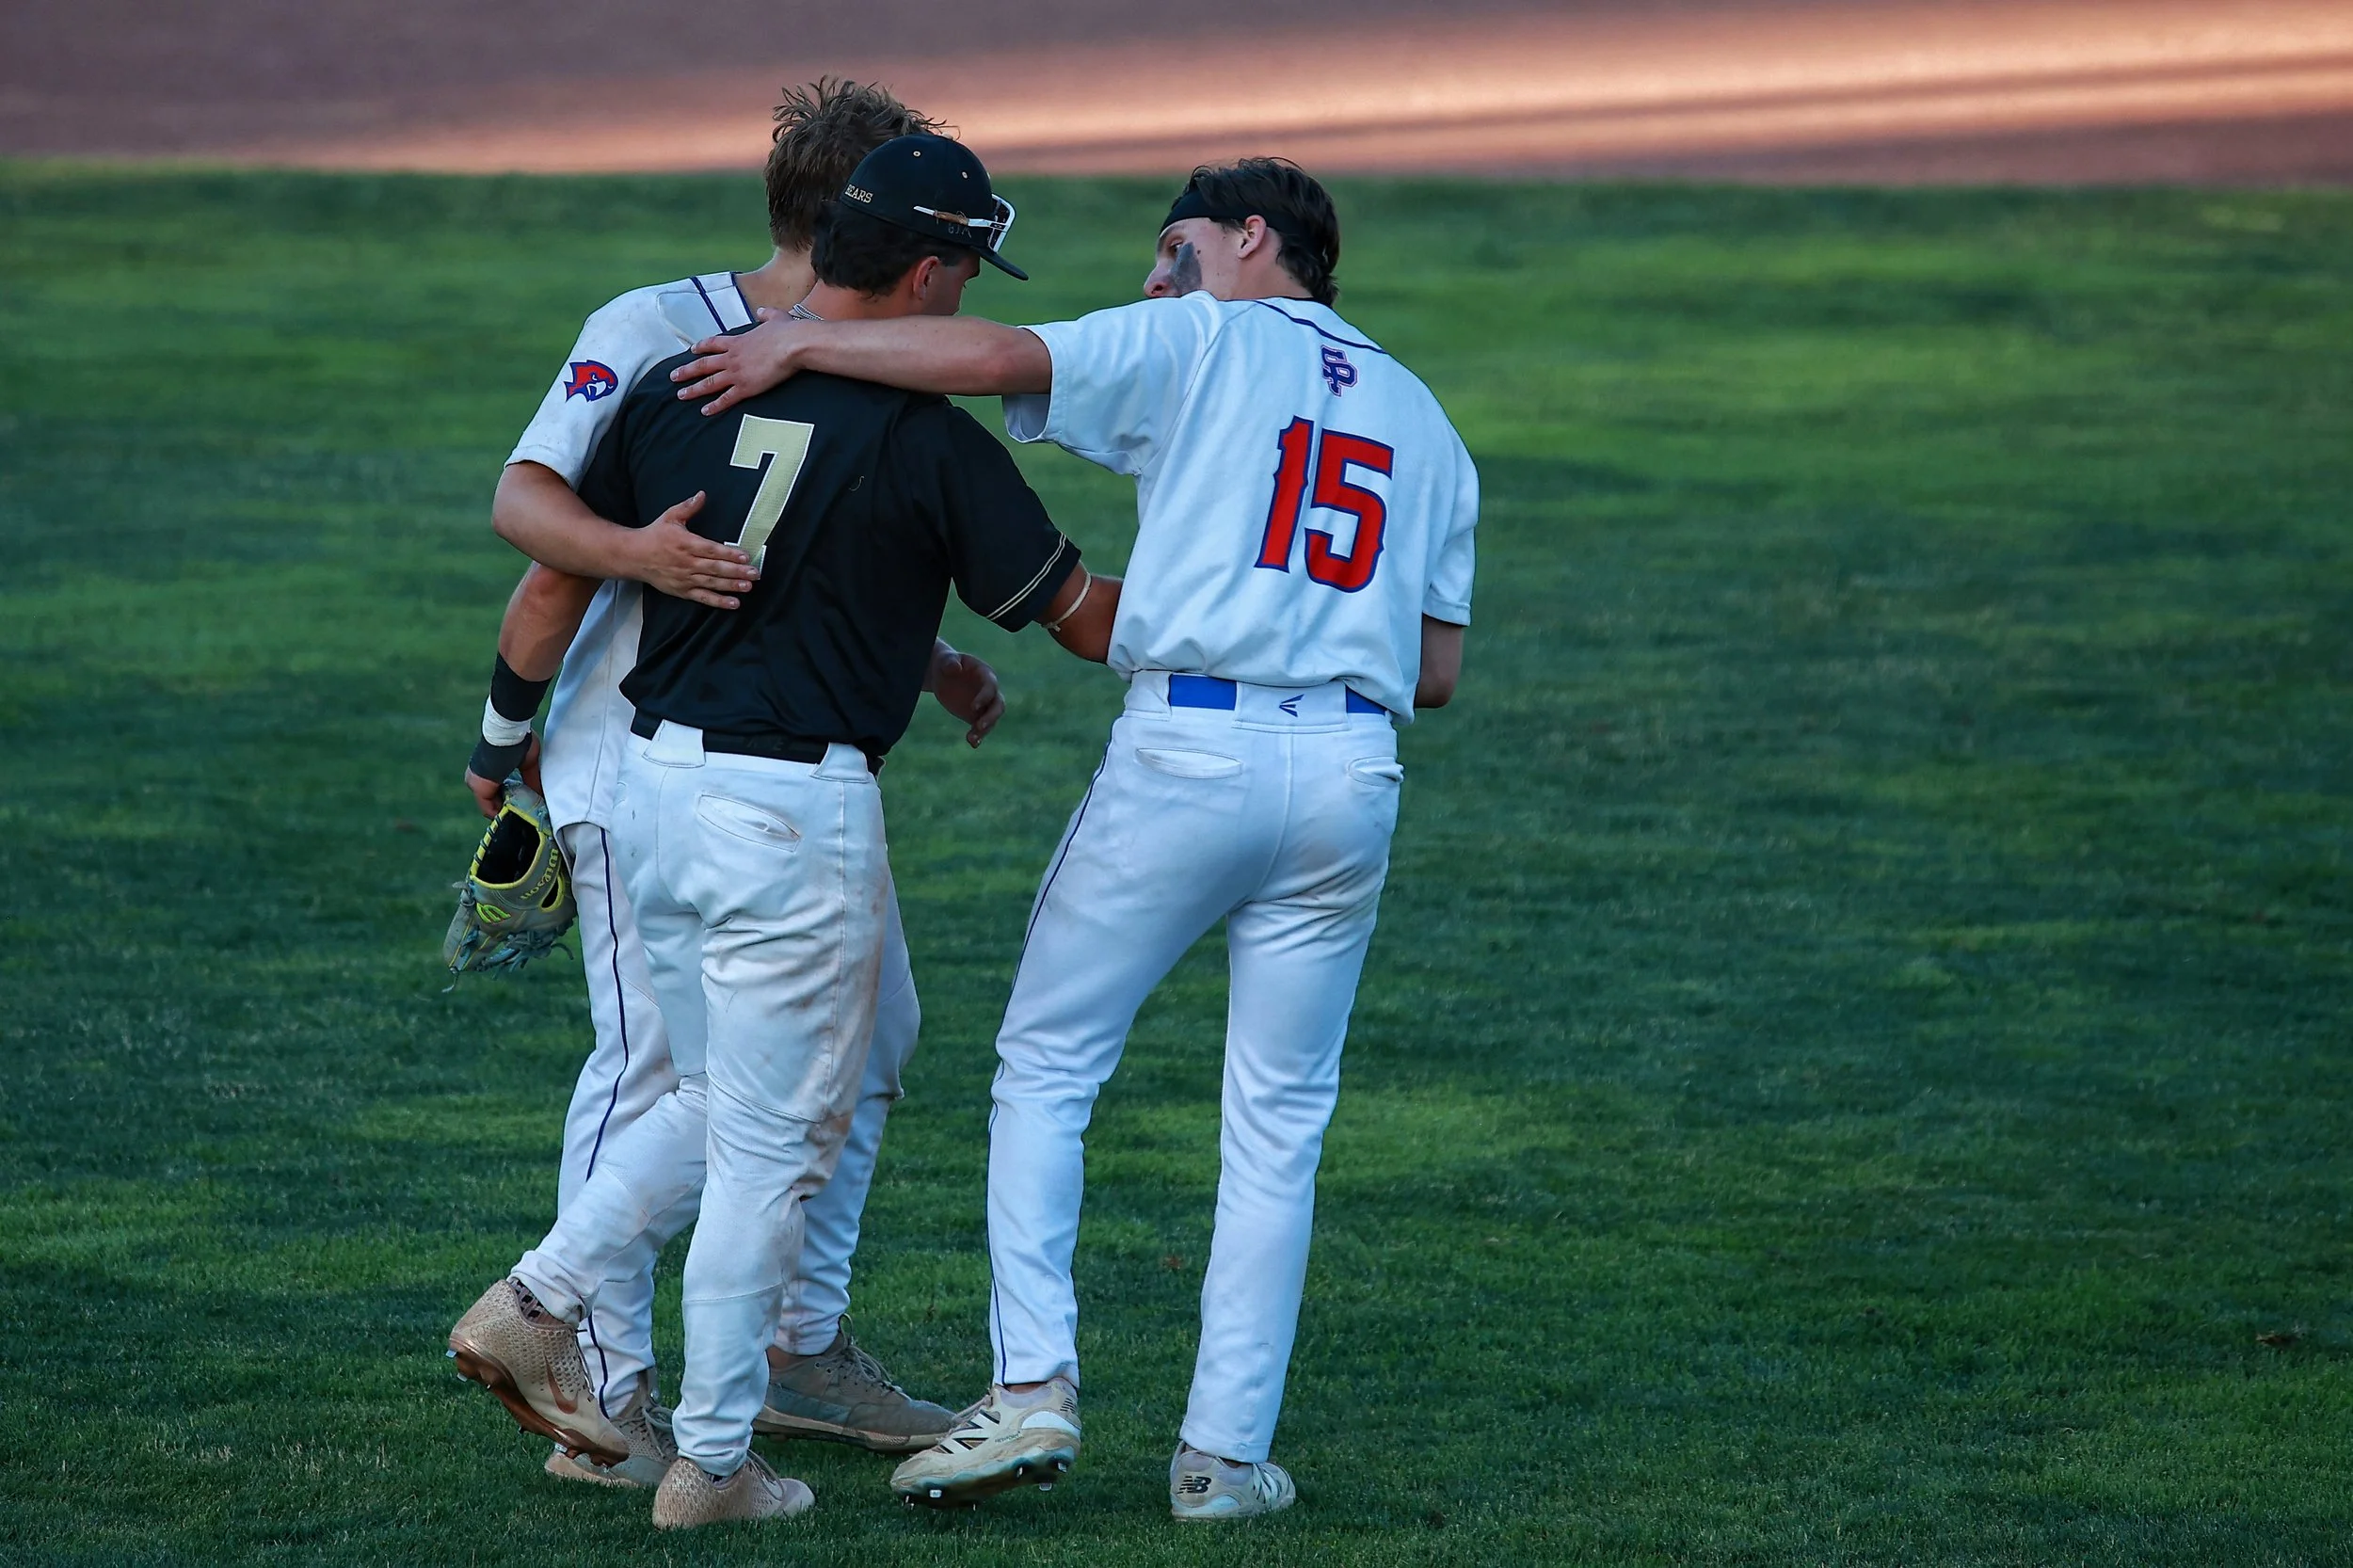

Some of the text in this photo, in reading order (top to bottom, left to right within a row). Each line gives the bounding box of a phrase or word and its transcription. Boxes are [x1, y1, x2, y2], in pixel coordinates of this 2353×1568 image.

[724, 413, 815, 580] 7
[1254, 414, 1395, 594] 15
[520, 848, 559, 900] Wilson
